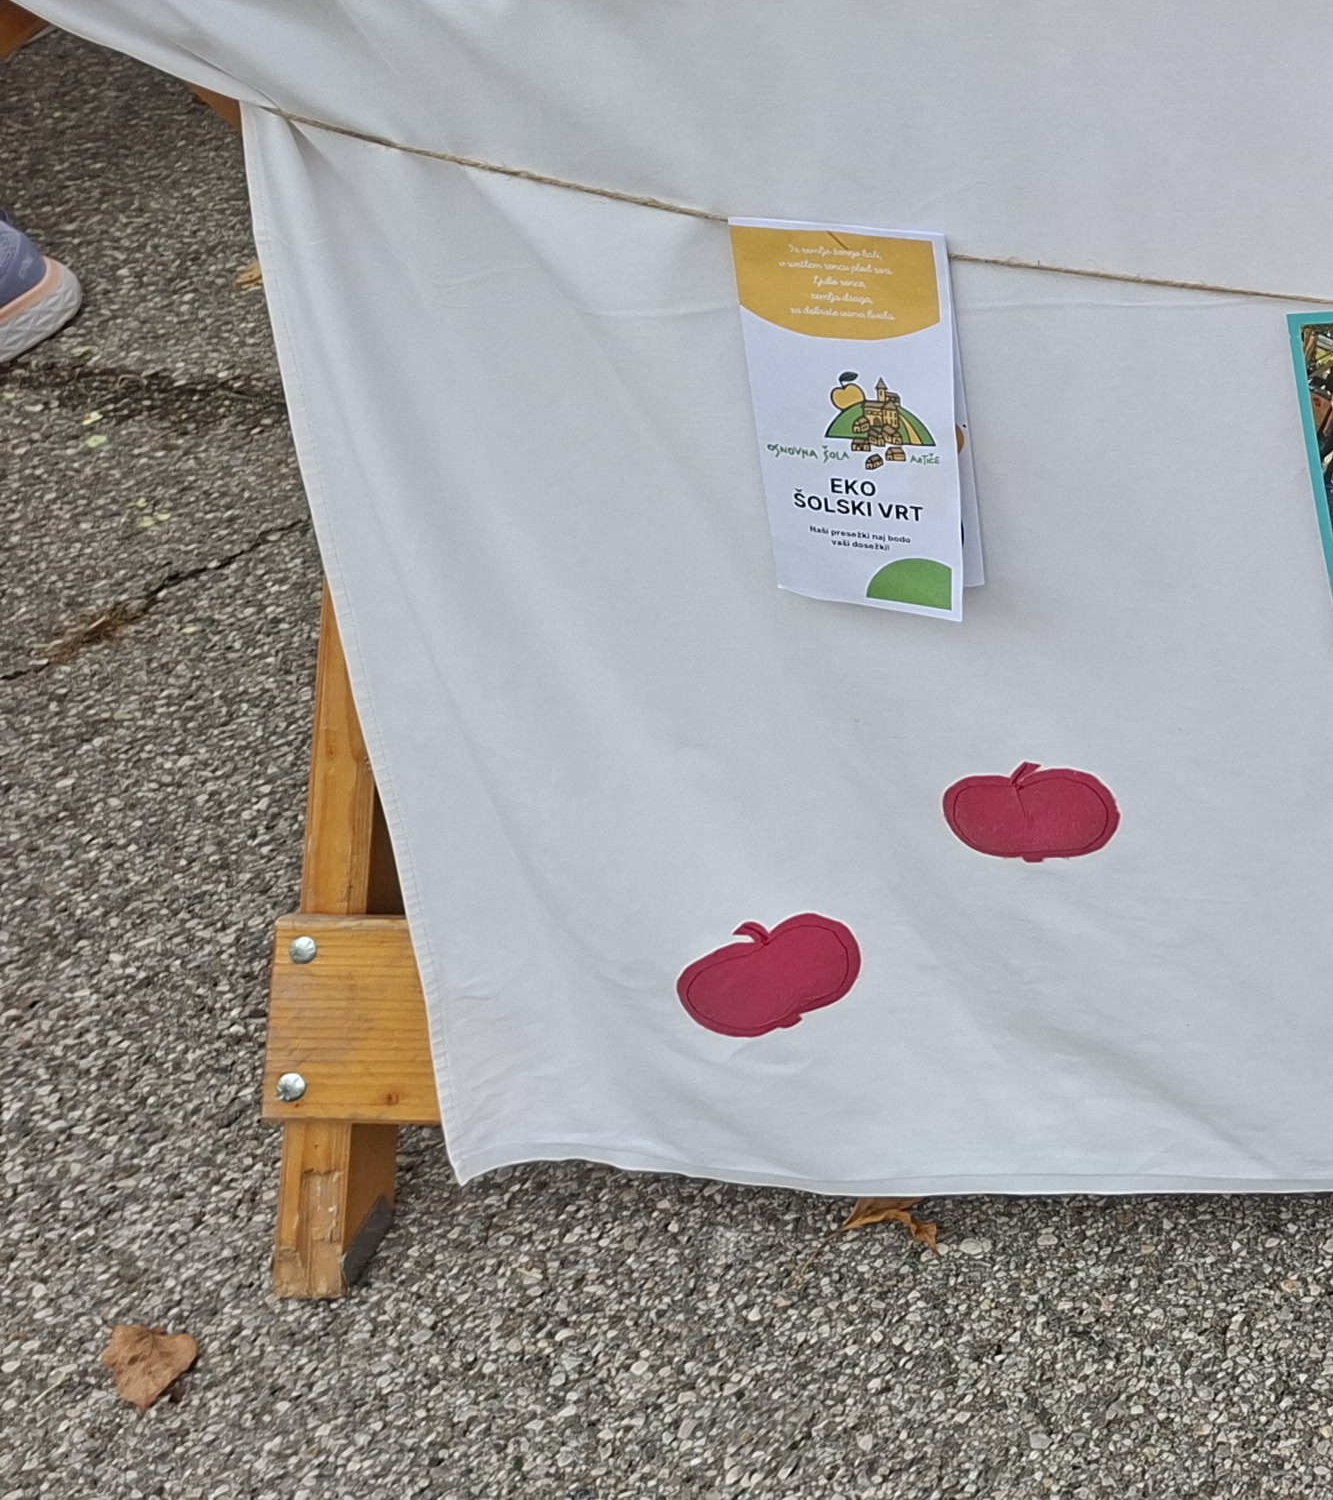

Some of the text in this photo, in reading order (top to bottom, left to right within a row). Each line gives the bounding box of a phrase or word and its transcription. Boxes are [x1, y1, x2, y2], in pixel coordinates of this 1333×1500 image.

[767, 443, 818, 459] OSNOVNA
[821, 445, 850, 463] ŠOLA
[830, 478, 876, 497] EKO
[794, 488, 923, 521] ŠOLSKI VRT
[809, 525, 911, 543] Naši presežki naj bodo
[831, 539, 850, 547] vaši
